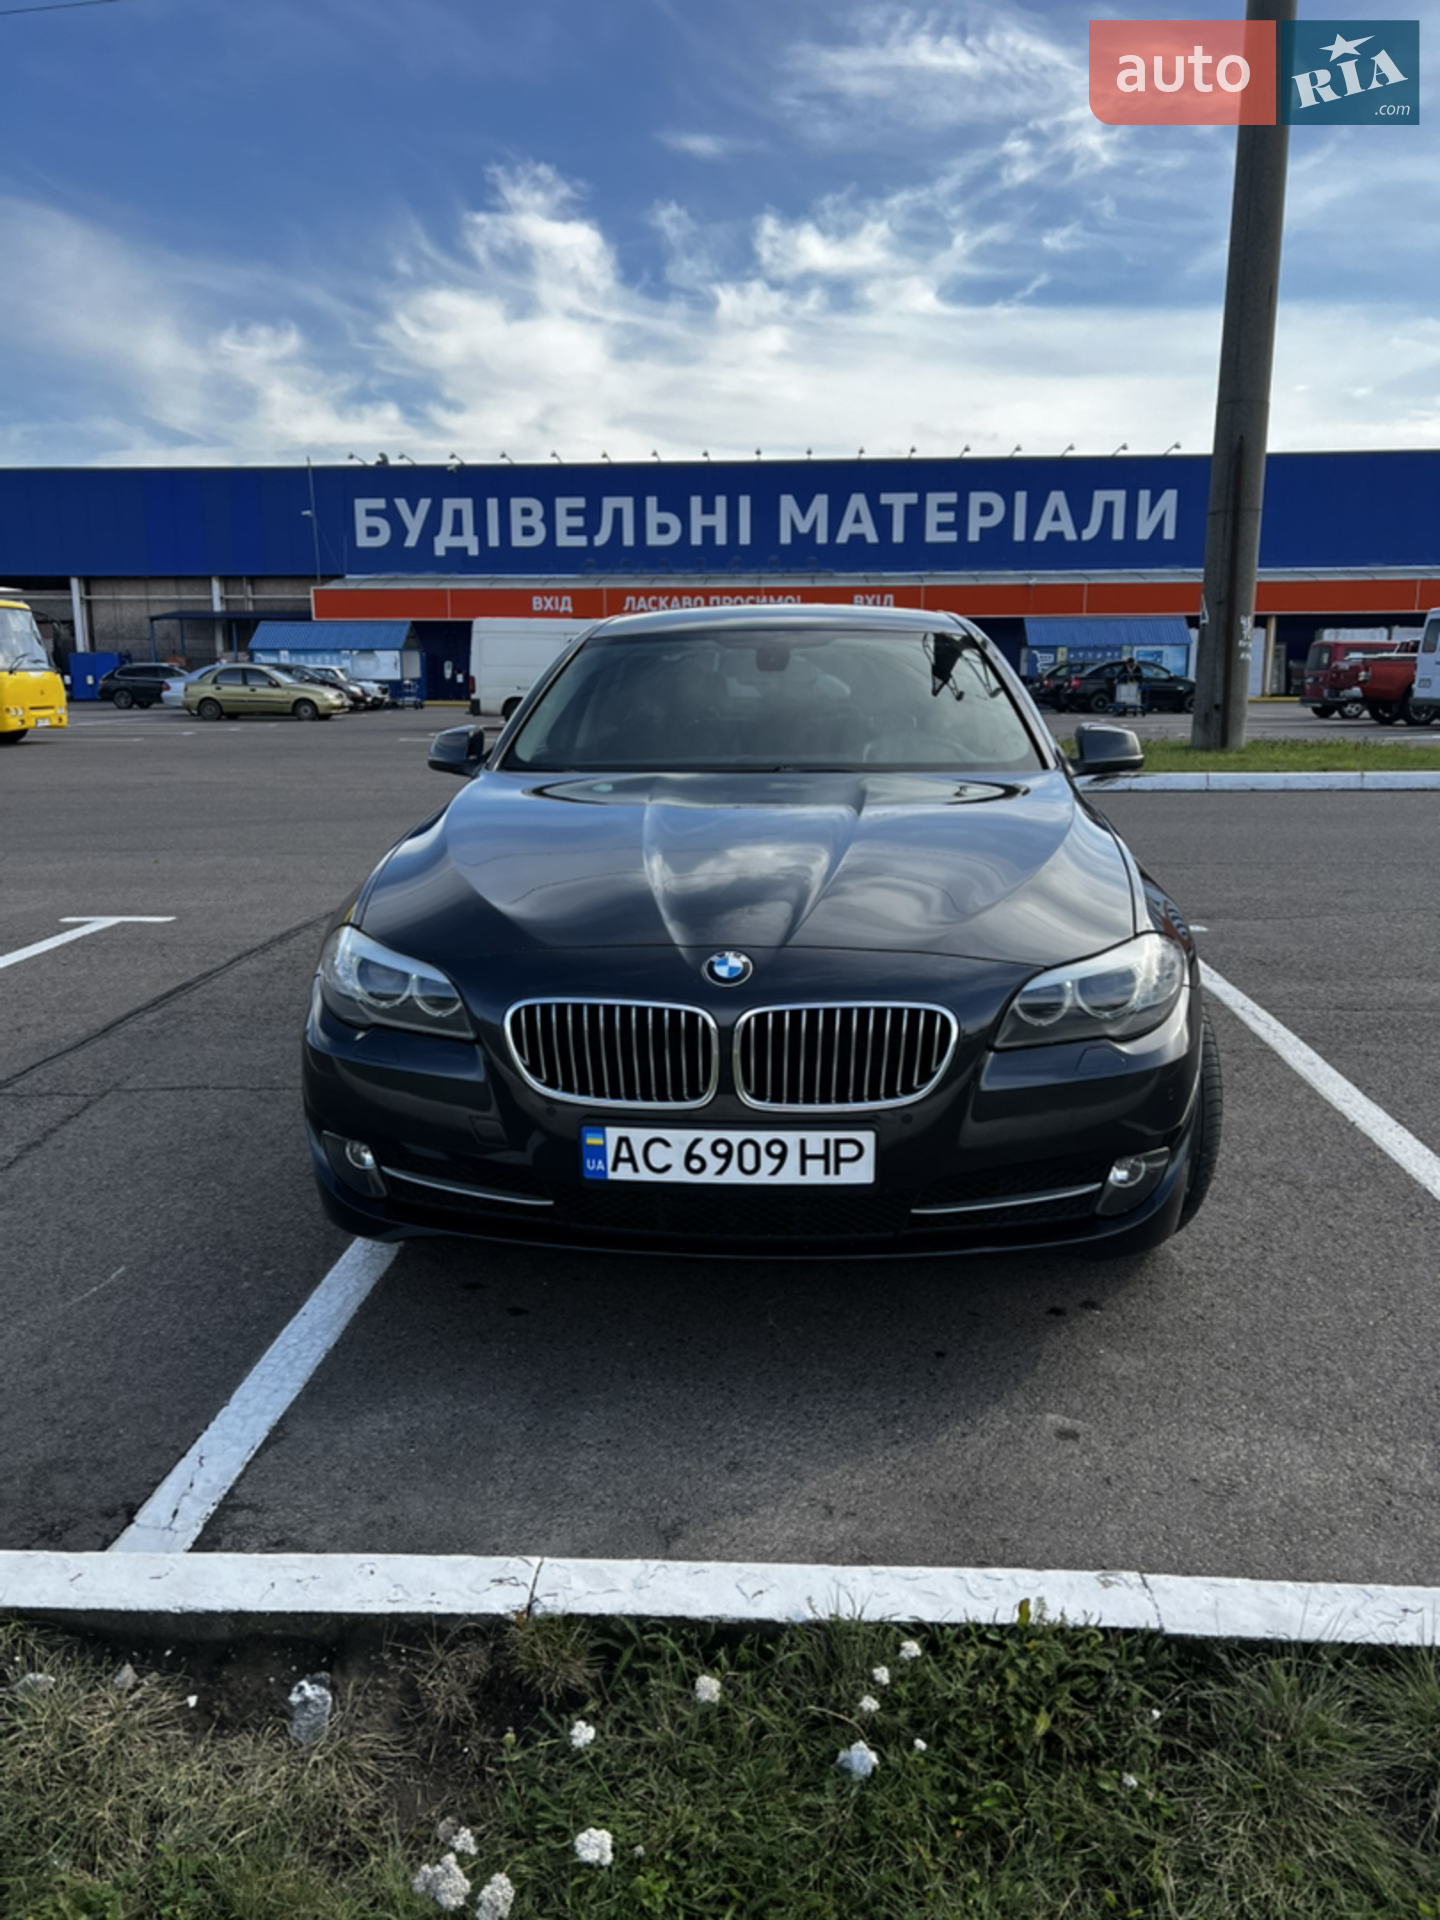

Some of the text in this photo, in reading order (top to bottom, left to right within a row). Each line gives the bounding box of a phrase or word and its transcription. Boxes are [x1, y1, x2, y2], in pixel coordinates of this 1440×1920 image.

[354, 488, 1179, 557] БУДІВЕЛЬНІ МАТЕРІАЛИ
[532, 596, 573, 613] ВХІД
[586, 1158, 605, 1171] UA
[611, 1135, 865, 1176] AC 6909 HP
